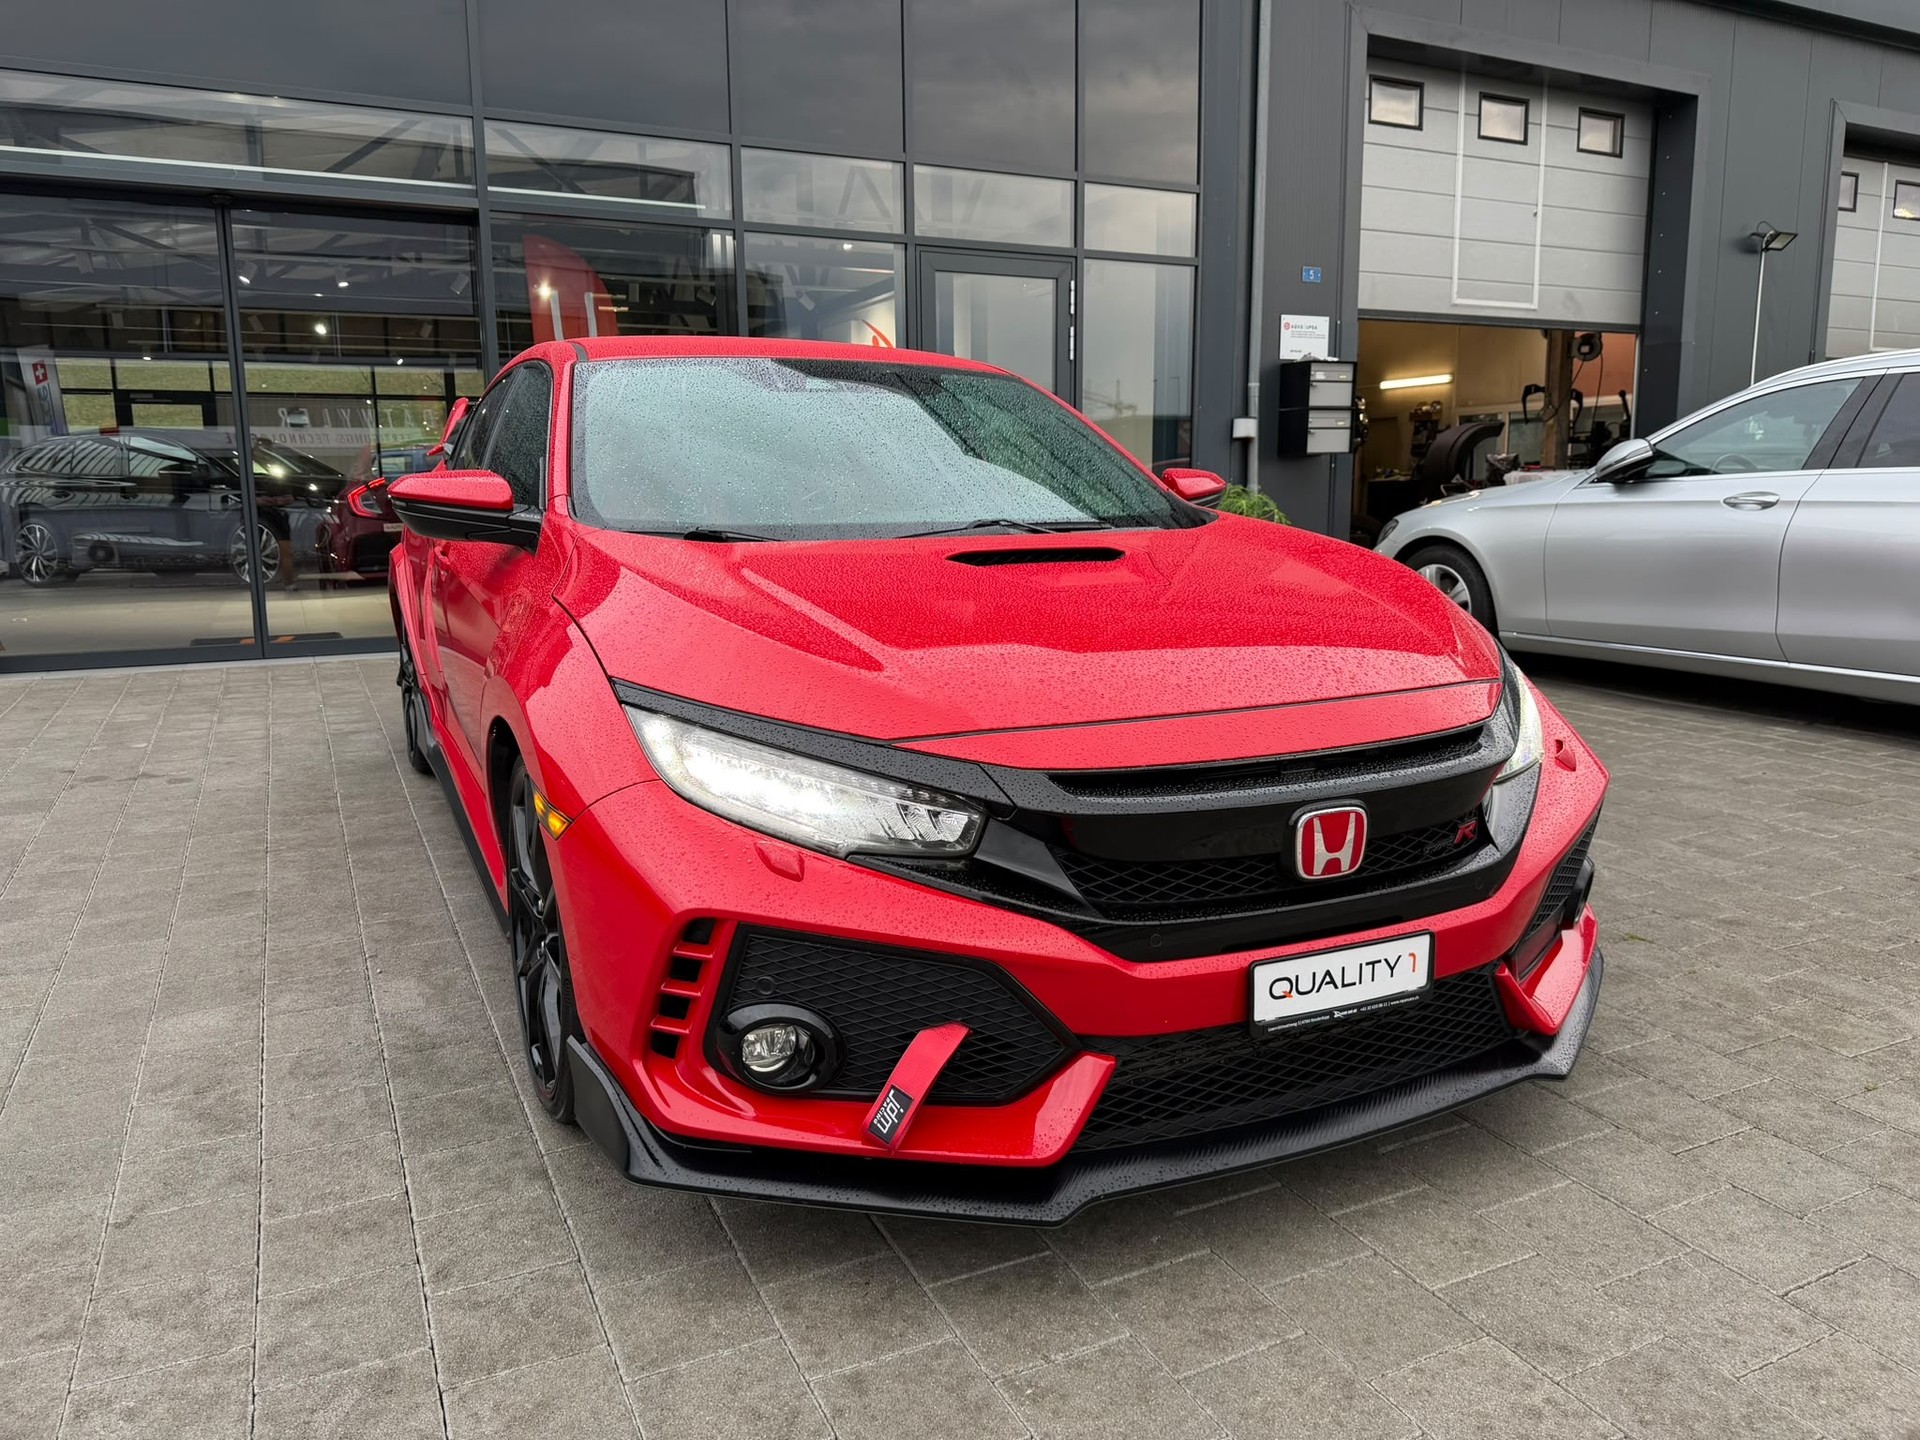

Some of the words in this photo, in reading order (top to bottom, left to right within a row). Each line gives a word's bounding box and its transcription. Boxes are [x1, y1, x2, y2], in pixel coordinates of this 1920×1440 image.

[1309, 269, 1315, 280] 5
[1268, 954, 1402, 1000] QUALITY
[1408, 952, 1417, 973] 1
[873, 1097, 891, 1125] RACING
[876, 1089, 904, 1134] jdm
